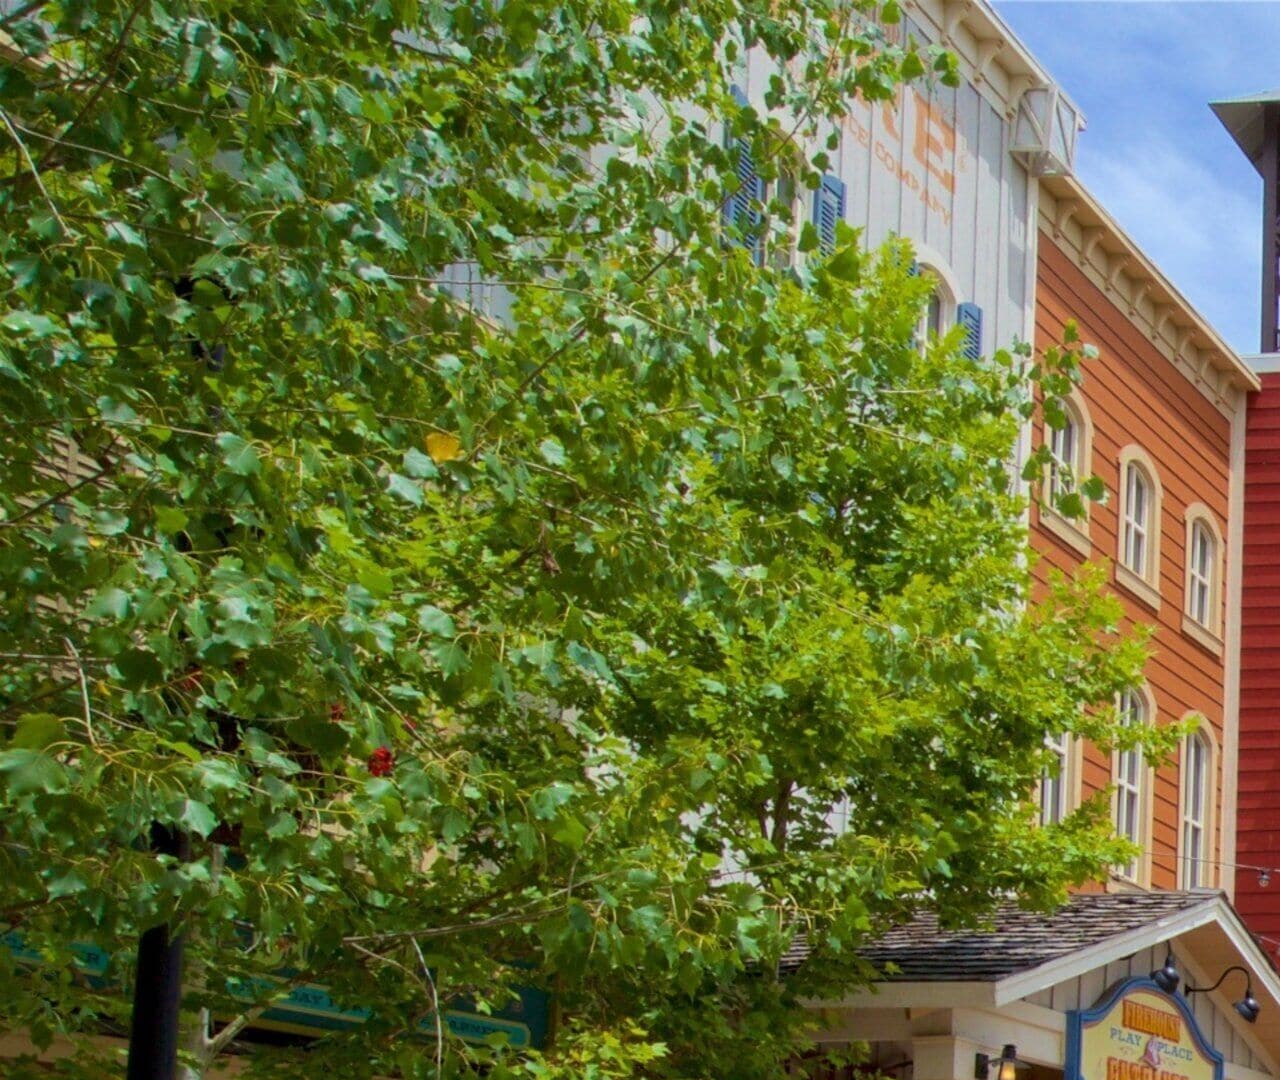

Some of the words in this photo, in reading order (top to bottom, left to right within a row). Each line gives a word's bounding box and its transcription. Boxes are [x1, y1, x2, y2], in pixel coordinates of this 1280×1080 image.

[874, 140, 952, 226] COMPANY
[1123, 999, 1181, 1043] FIREHOUSE
[1110, 1026, 1142, 1047] PLAY
[1157, 1041, 1193, 1061] PLACE
